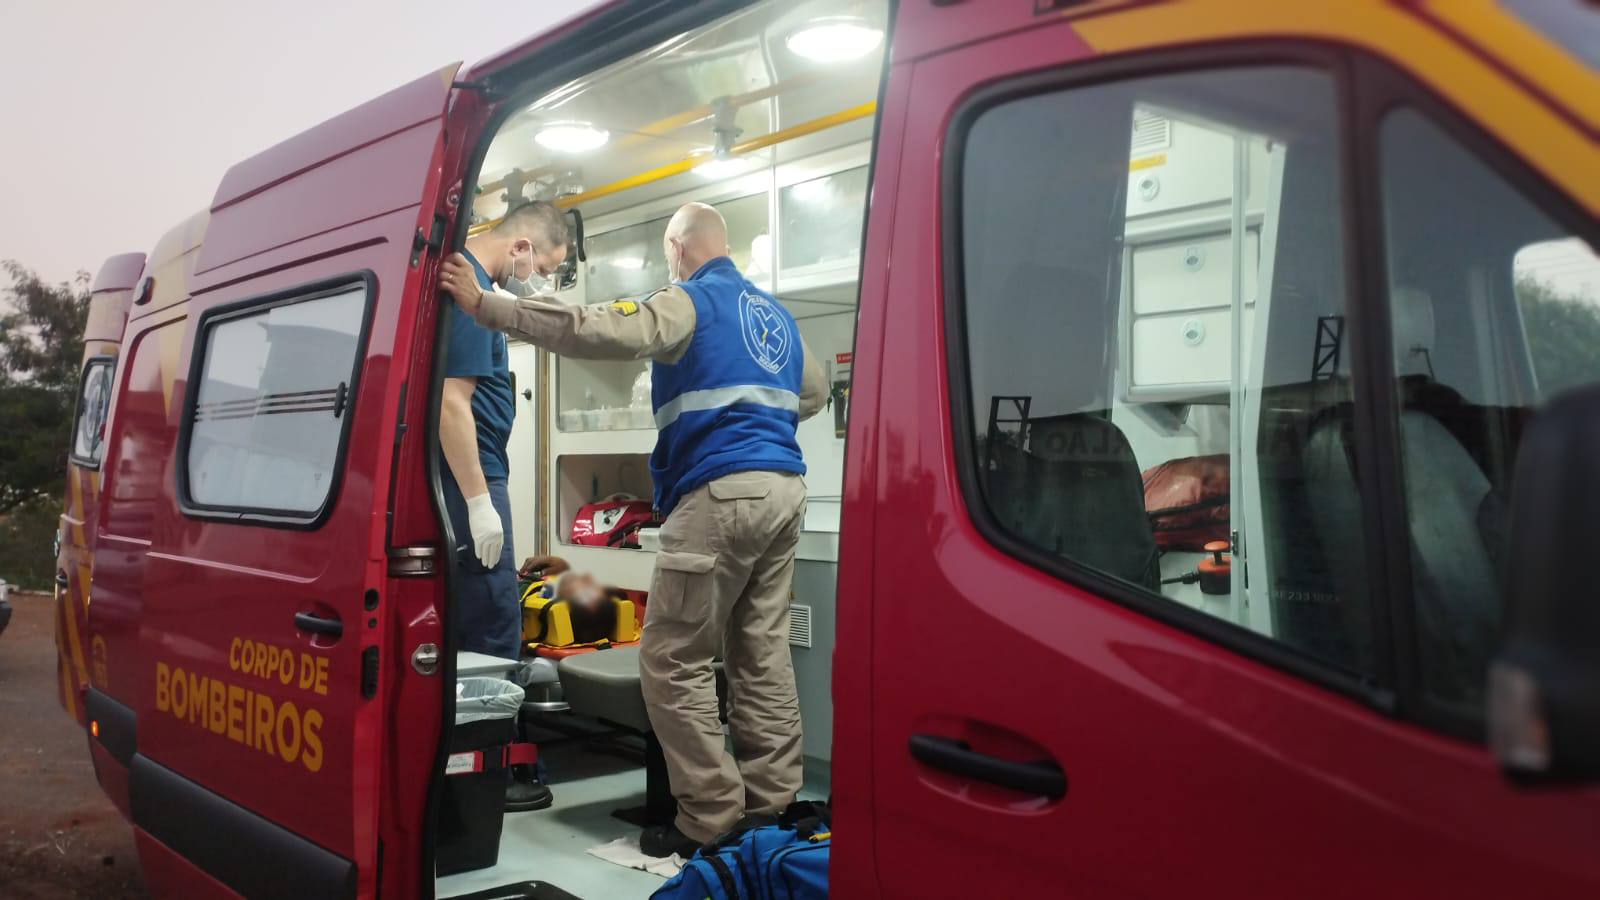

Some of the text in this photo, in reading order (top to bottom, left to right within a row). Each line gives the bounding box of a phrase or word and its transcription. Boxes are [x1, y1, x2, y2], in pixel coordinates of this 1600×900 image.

[229, 637, 329, 695] CORPO DE
[156, 661, 324, 772] BOMBEIROS
